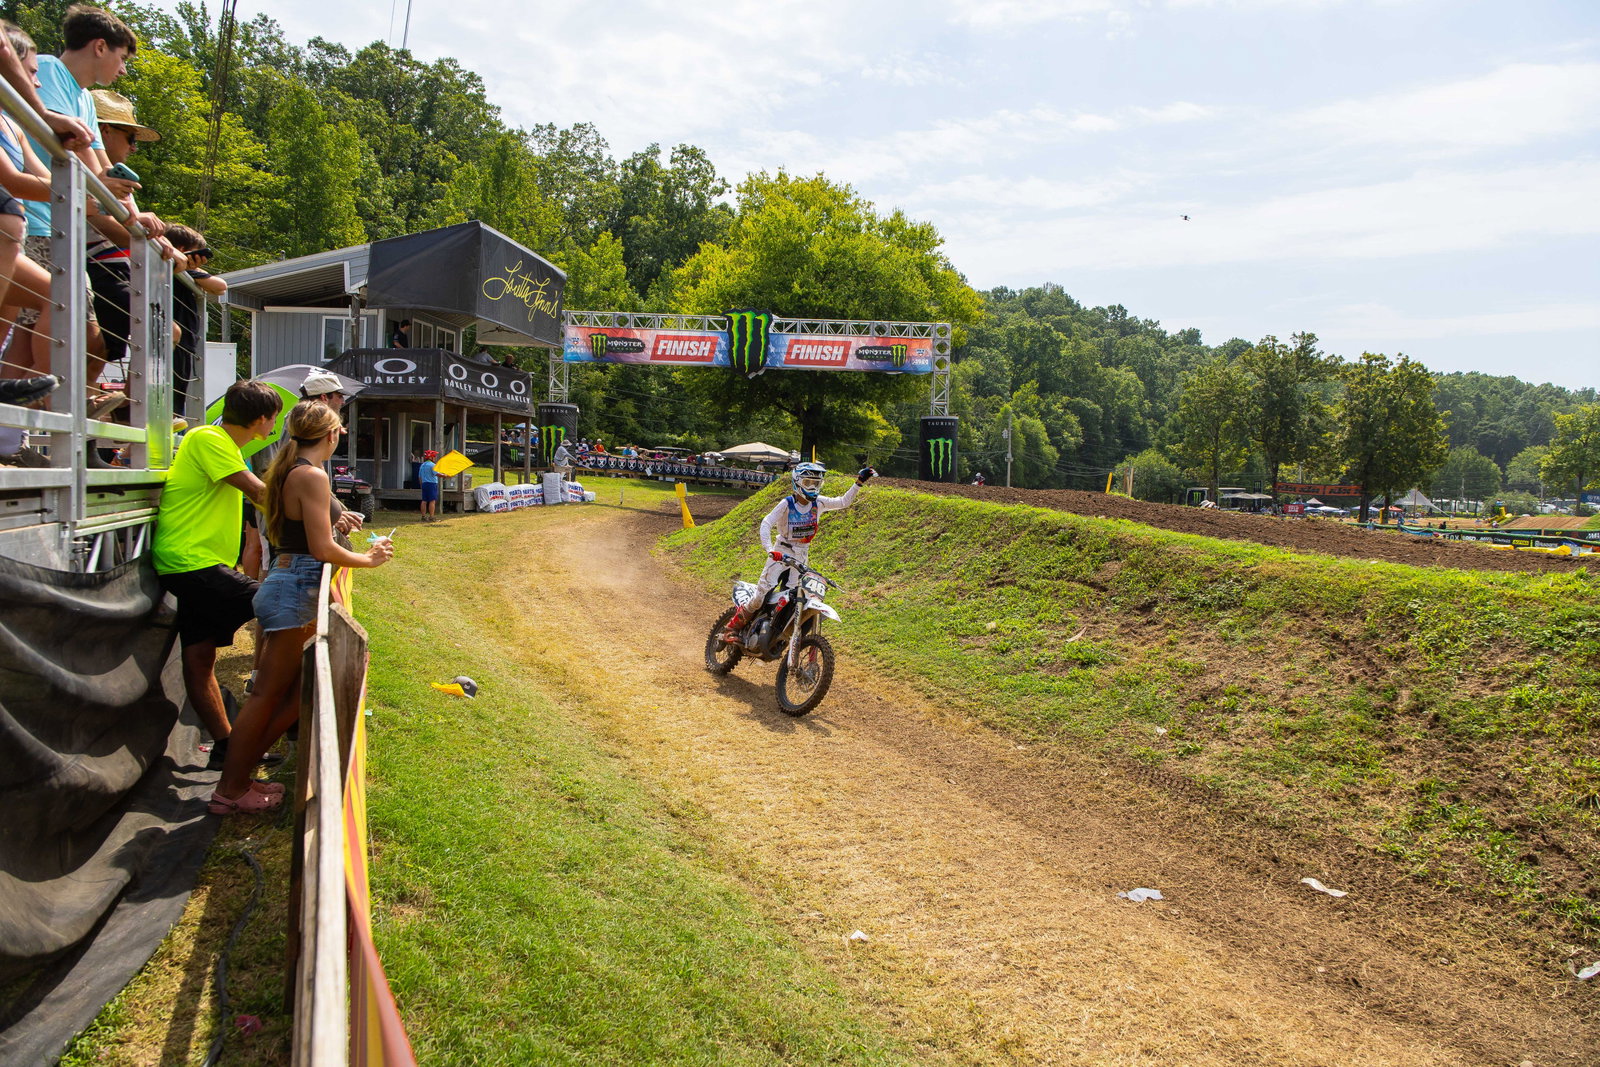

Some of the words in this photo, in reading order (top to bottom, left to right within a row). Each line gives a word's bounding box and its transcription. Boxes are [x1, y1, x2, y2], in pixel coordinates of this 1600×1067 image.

[606, 340, 643, 348] MONSTER
[657, 339, 711, 356] FINISH
[791, 344, 844, 360] FINISH
[364, 376, 428, 384] OAKLEY
[444, 378, 472, 392] OAKLEY
[477, 386, 502, 398] OAKLEY
[506, 393, 530, 404] OAKLEY
[805, 579, 826, 597] 46
[734, 590, 751, 606] 46
